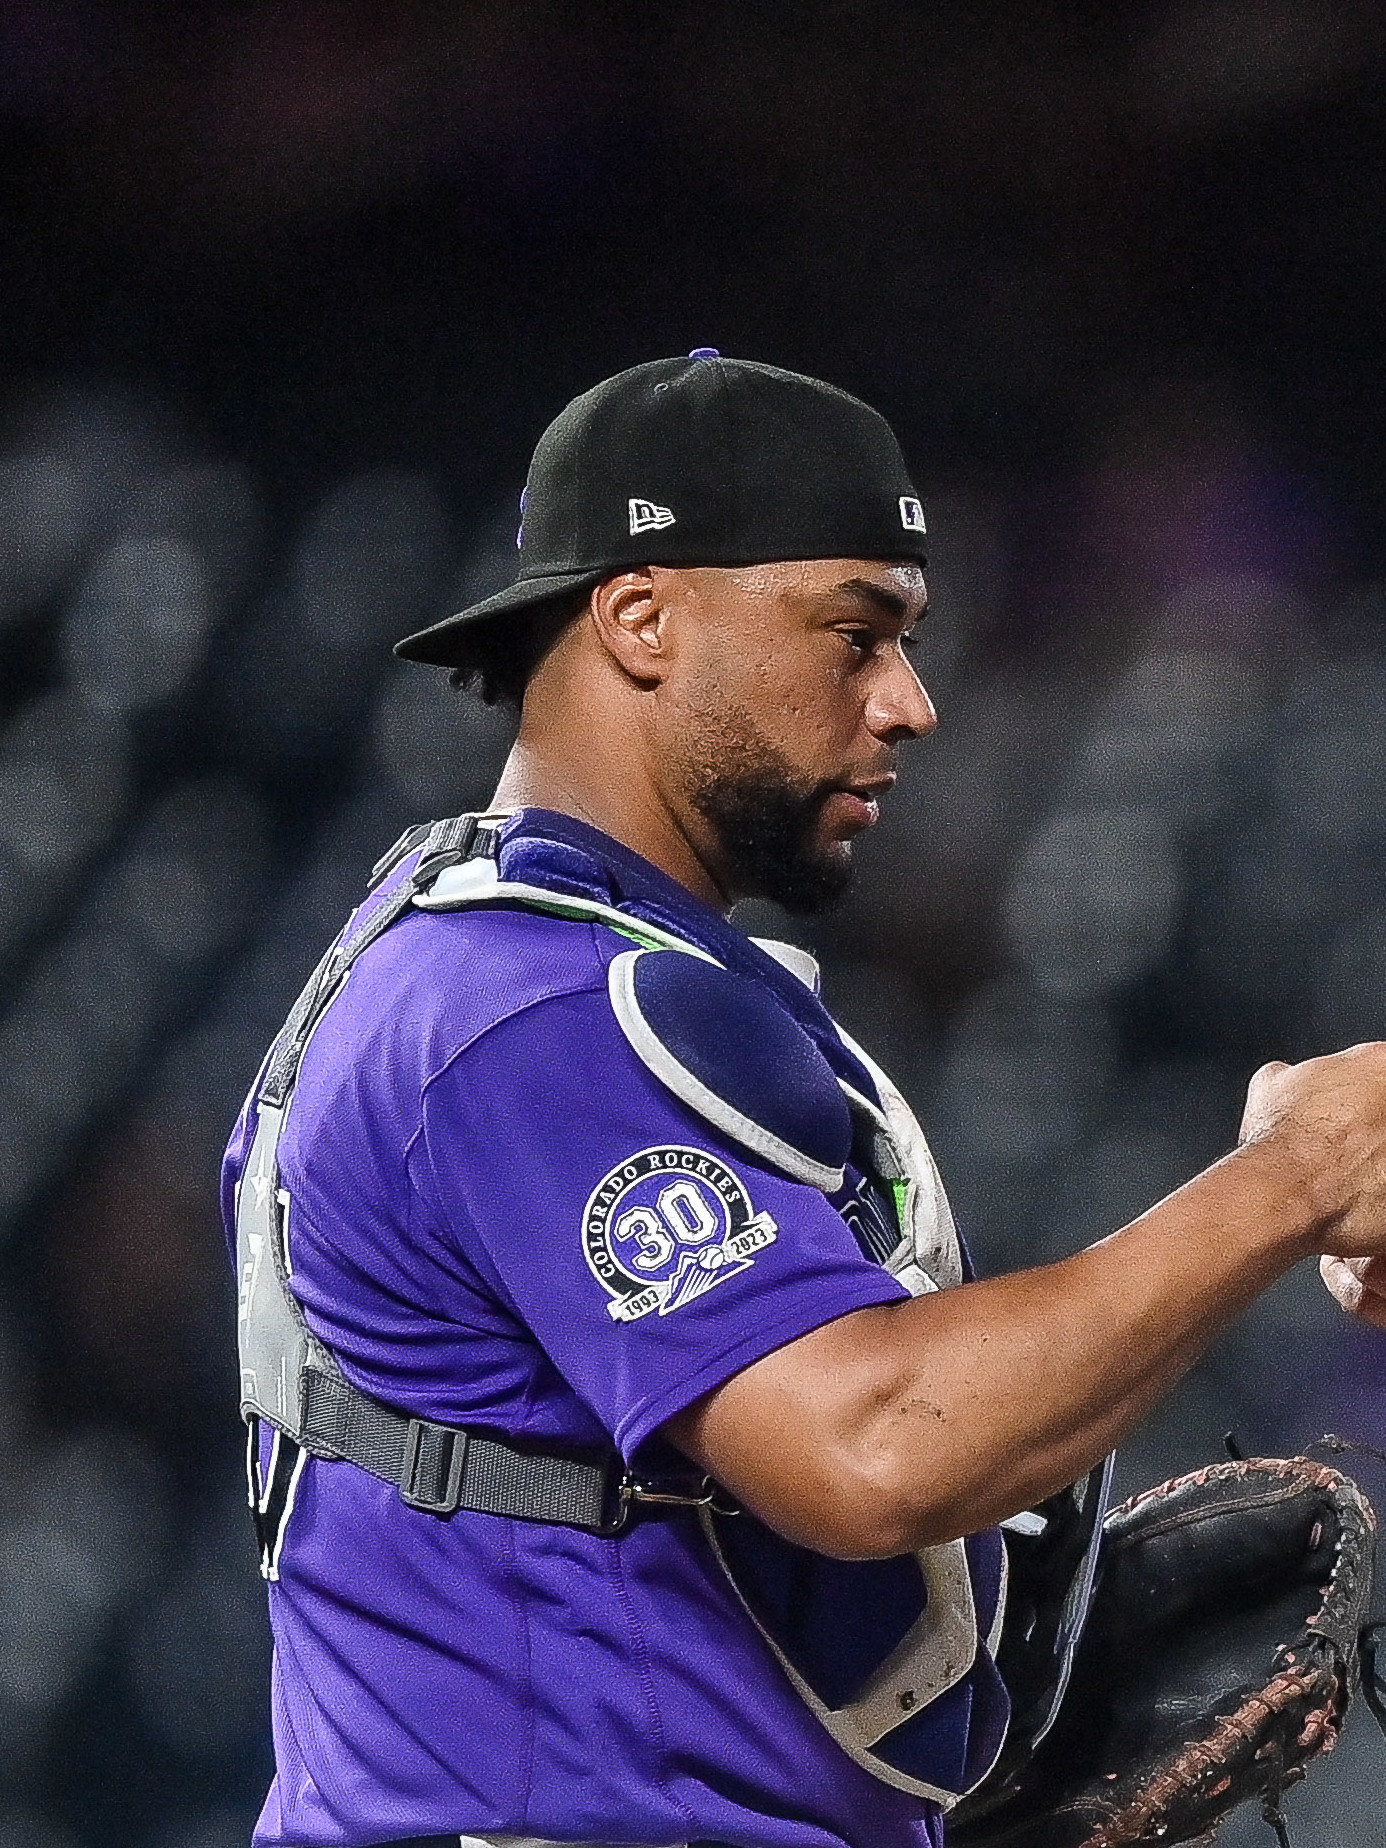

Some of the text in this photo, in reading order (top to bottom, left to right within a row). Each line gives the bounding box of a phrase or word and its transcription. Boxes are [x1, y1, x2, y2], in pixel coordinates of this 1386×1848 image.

[588, 1152, 741, 1279] COLORADO ROCKIES
[614, 1179, 719, 1272] 30
[730, 1227, 768, 1256] 2023
[625, 1289, 660, 1317] 1993
